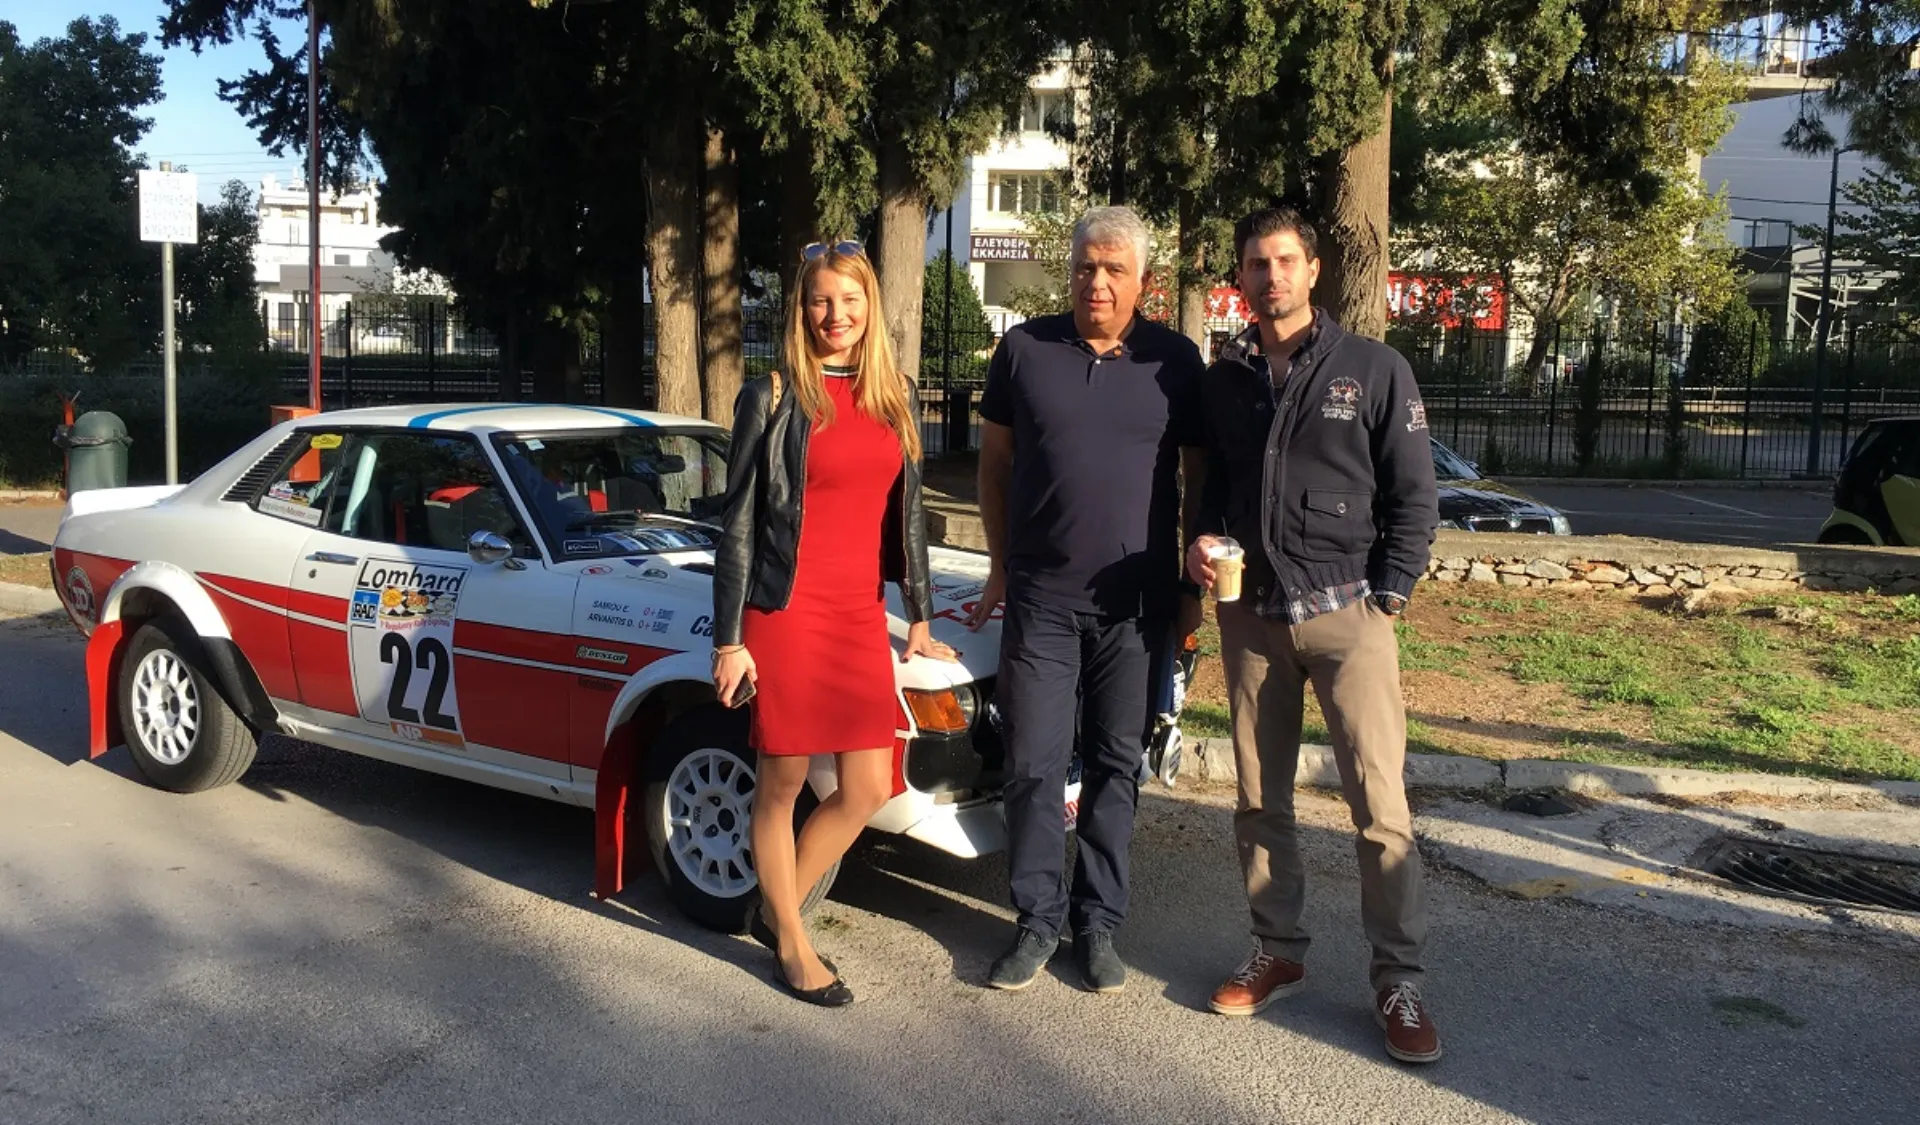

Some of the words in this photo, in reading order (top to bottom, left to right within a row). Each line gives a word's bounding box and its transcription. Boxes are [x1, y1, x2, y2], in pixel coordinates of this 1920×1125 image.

[974, 237, 1031, 248] ΕΛΕΥΘΕΡΑ
[972, 248, 1029, 260] ΕΚΚΛΗΣΙΑ
[353, 602, 377, 620] RAC
[588, 649, 627, 662] DUNLOP
[380, 632, 458, 731] 22
